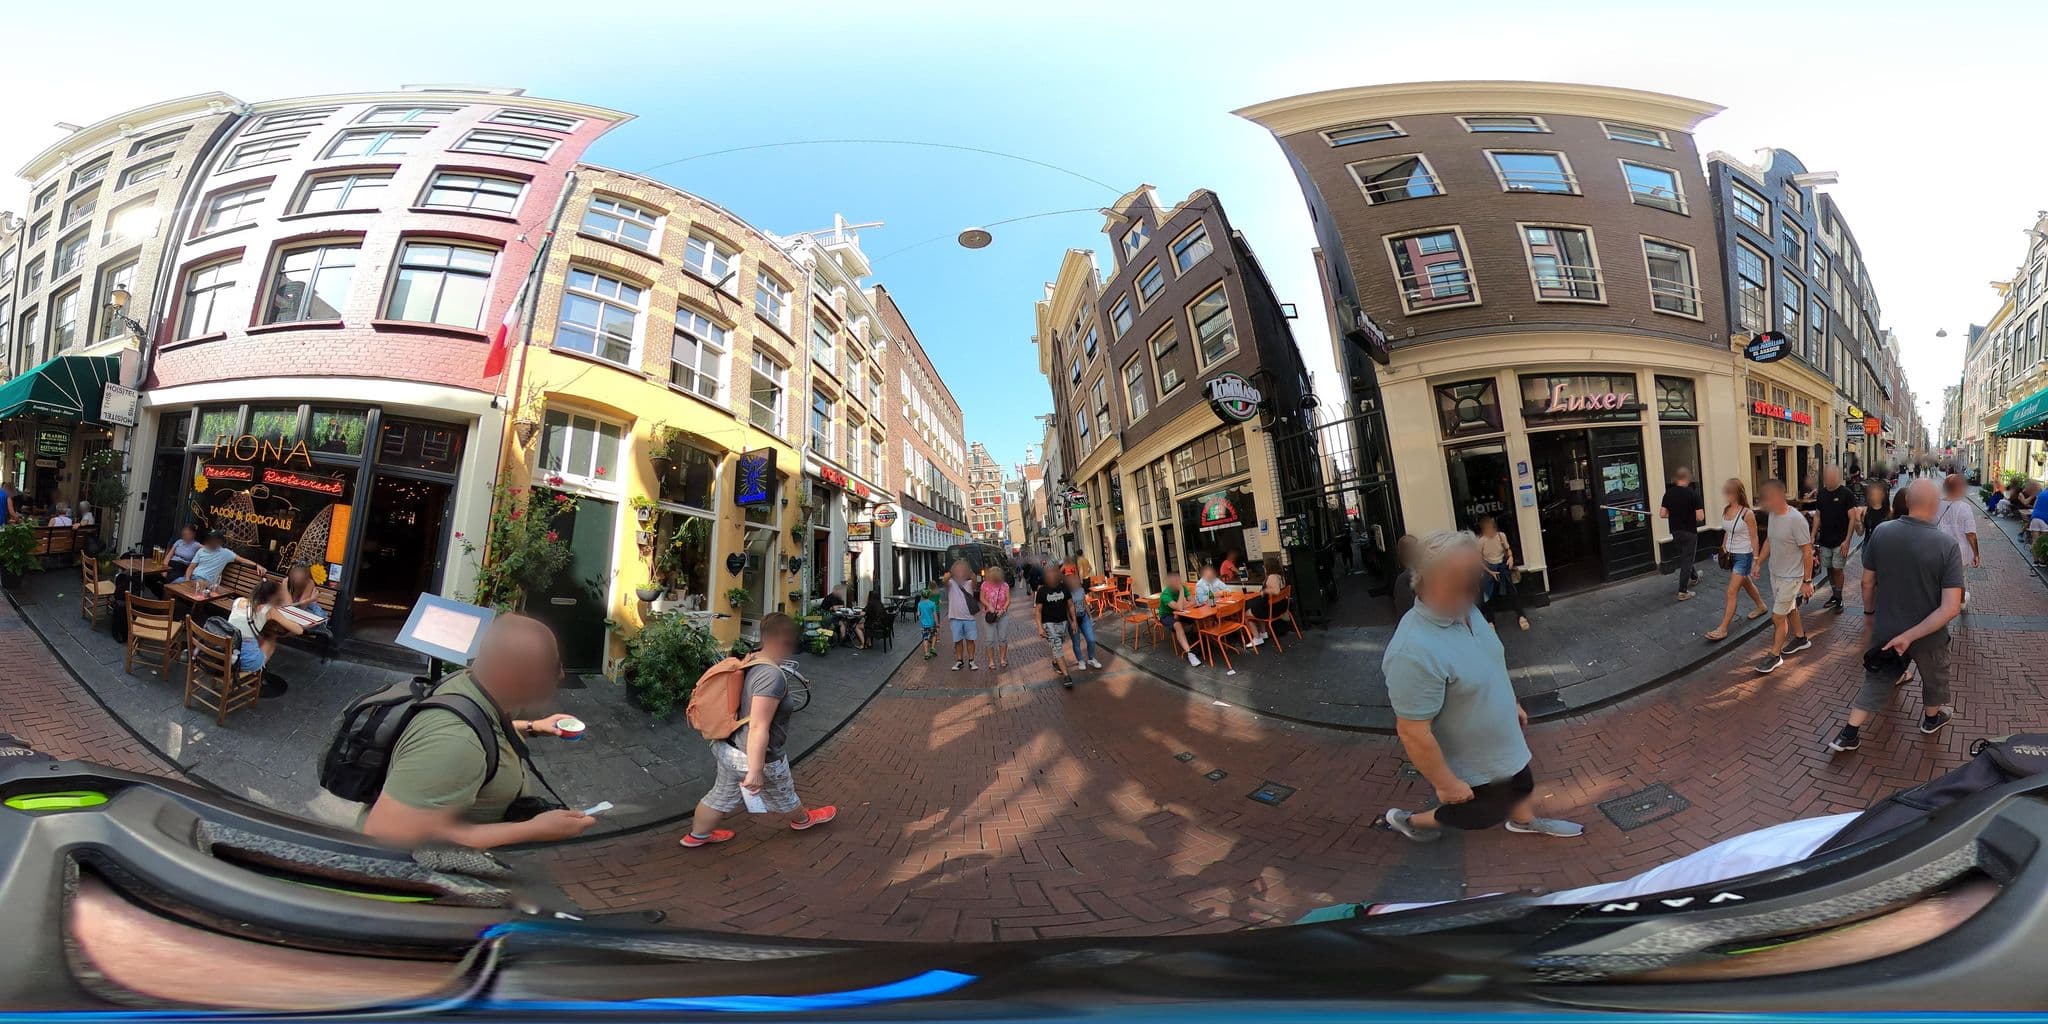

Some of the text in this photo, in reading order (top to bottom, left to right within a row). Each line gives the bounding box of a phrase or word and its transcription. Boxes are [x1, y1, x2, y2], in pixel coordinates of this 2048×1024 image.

[1206, 377, 1262, 402] TOMMASO
[1546, 384, 1632, 413] Luxer
[1755, 400, 1785, 419] STEAK
[213, 434, 312, 467] FIONA
[264, 470, 343, 493] Restaurant
[210, 505, 292, 531] TACOS & COCKTAILS
[1466, 501, 1504, 515] HOTEL
